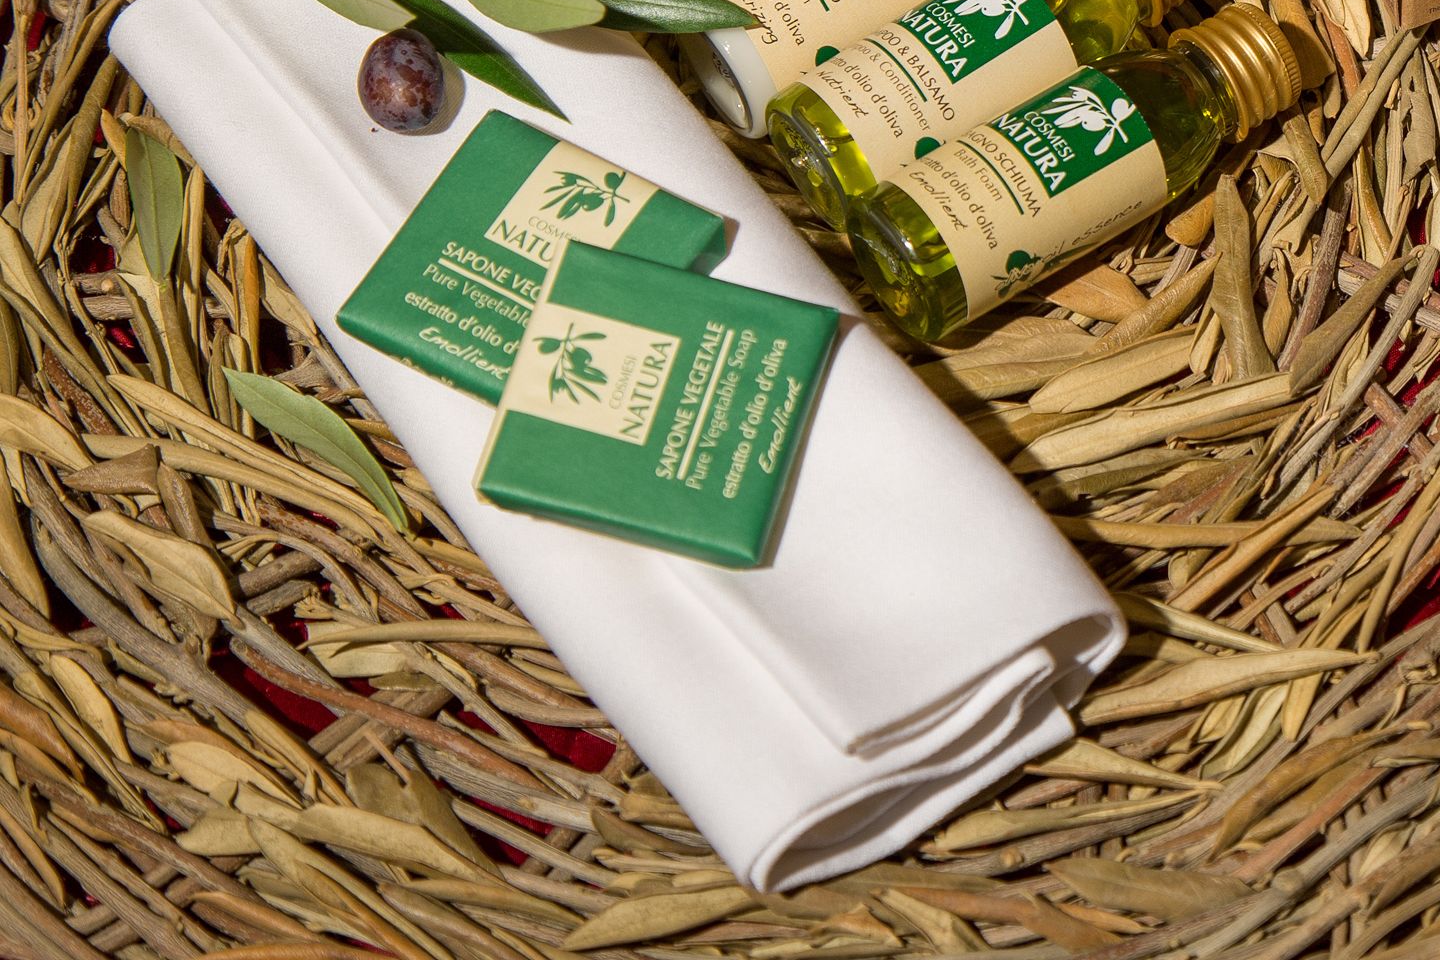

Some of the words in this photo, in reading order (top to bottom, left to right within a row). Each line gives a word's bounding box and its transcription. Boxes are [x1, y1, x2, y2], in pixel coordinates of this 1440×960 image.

[774, 1, 805, 46] d'oliva
[901, 9, 968, 77] NATURA
[926, 2, 975, 48] COSMESI
[816, 70, 868, 118] Nutrient
[843, 64, 872, 93] d'olio
[871, 94, 904, 138] d'oliva
[870, 53, 880, 63] &
[880, 61, 931, 131] Conditioner
[897, 45, 910, 56] &
[907, 54, 955, 121] BALSAMO
[991, 113, 1067, 192] NATURA
[1024, 111, 1076, 162] COSMESI
[909, 171, 968, 231] Emollient
[954, 149, 977, 169] Bath
[974, 167, 1002, 202] Foam
[967, 130, 998, 153] GNO
[994, 152, 1041, 218] SCHIUMA
[492, 220, 553, 262] NATU
[942, 171, 971, 201] d'olio
[969, 203, 998, 250] d'oliva
[423, 263, 459, 290] Pure
[441, 241, 511, 284] SAPONE
[404, 291, 458, 324] estratto
[459, 315, 503, 347] d'olio
[419, 326, 512, 380] Emollient
[608, 355, 638, 410] COSMESI
[619, 342, 672, 439] NATURA
[656, 407, 695, 480] SAPONE
[681, 320, 725, 406] VEGETALE
[685, 452, 713, 490] Pure
[699, 371, 740, 448] Vegetable
[728, 329, 757, 369] Soap
[723, 440, 752, 499] estratto
[739, 392, 769, 439] d'olio
[755, 338, 788, 392] d'oliva
[759, 375, 803, 474] Emollient
